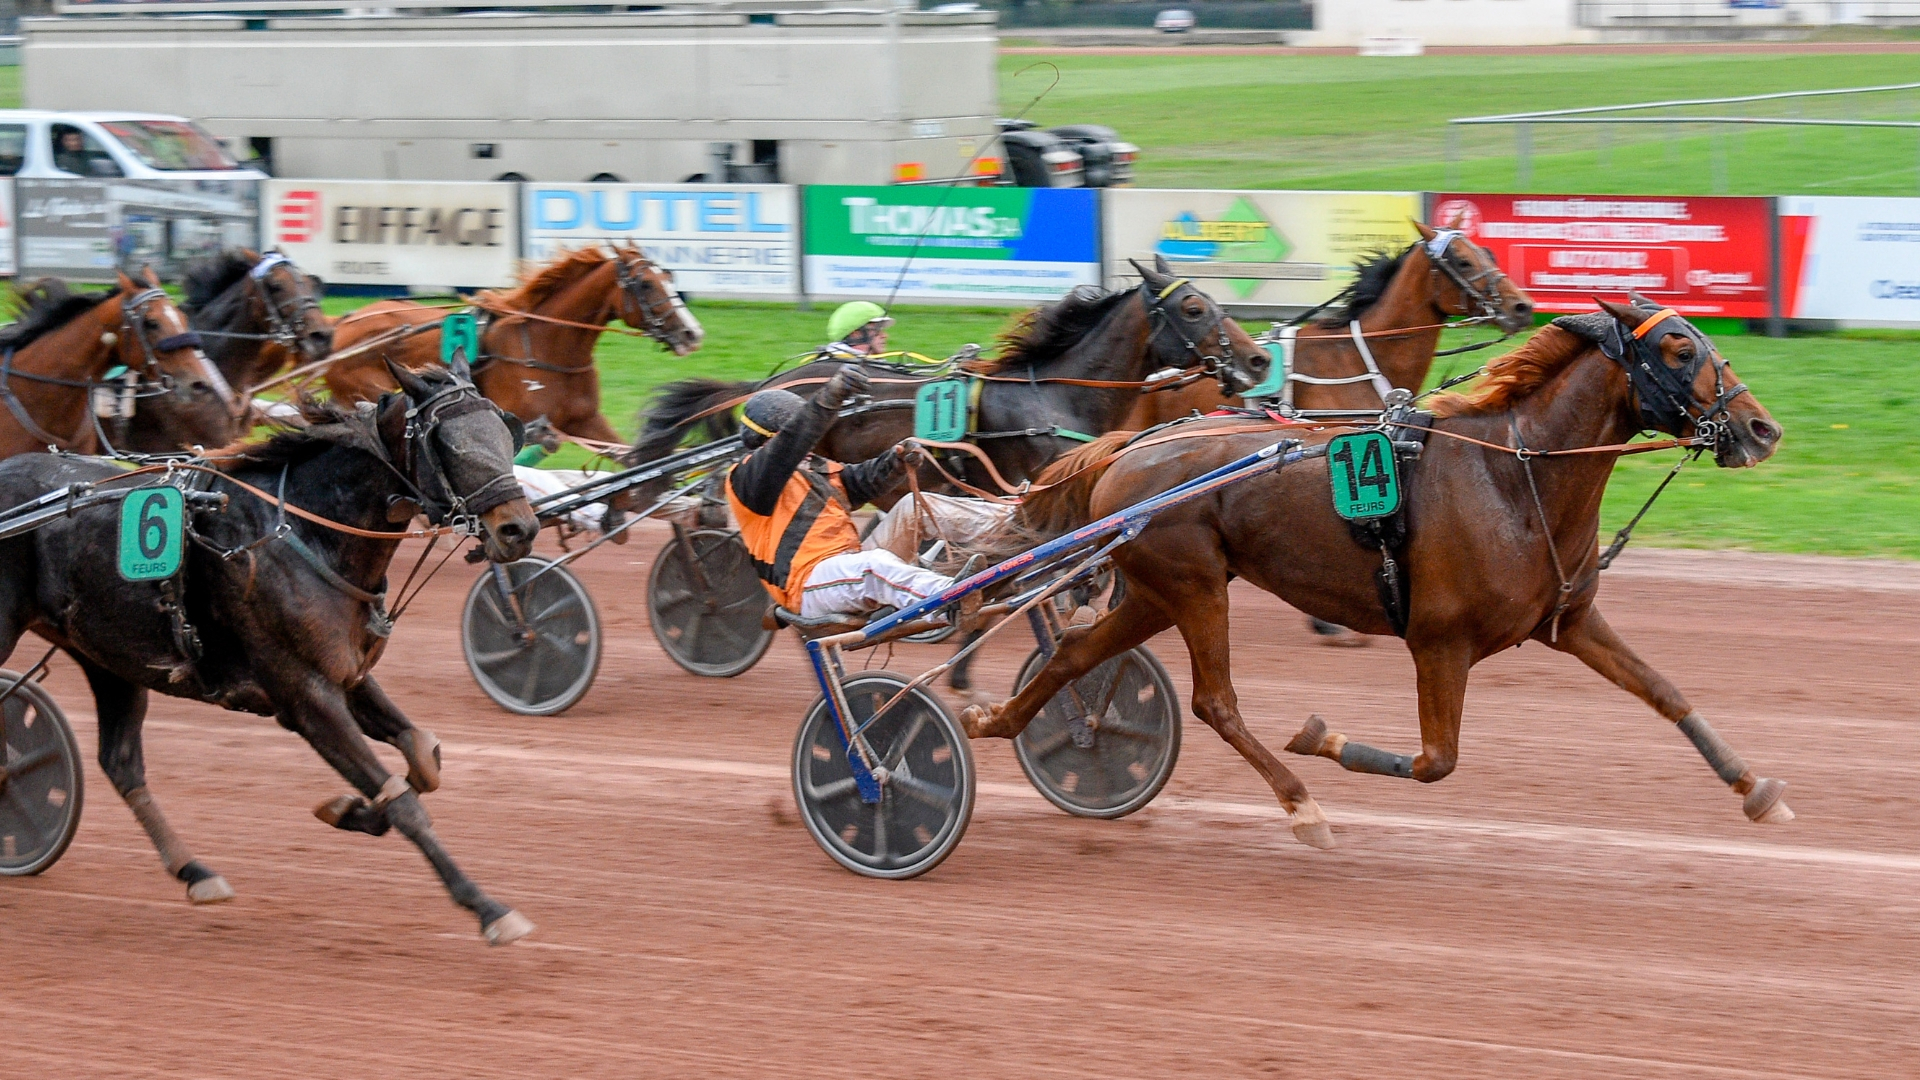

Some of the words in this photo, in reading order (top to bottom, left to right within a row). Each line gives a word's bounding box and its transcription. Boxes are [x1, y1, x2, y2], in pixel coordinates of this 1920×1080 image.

[334, 206, 503, 246] EIFFAGE
[531, 190, 790, 232] DUTEL
[843, 198, 995, 236] THOMAS
[924, 384, 958, 431] 11
[1333, 439, 1390, 501] 14
[138, 493, 168, 560] 6
[1350, 501, 1385, 514] FEURS
[132, 562, 167, 574] FEURS
